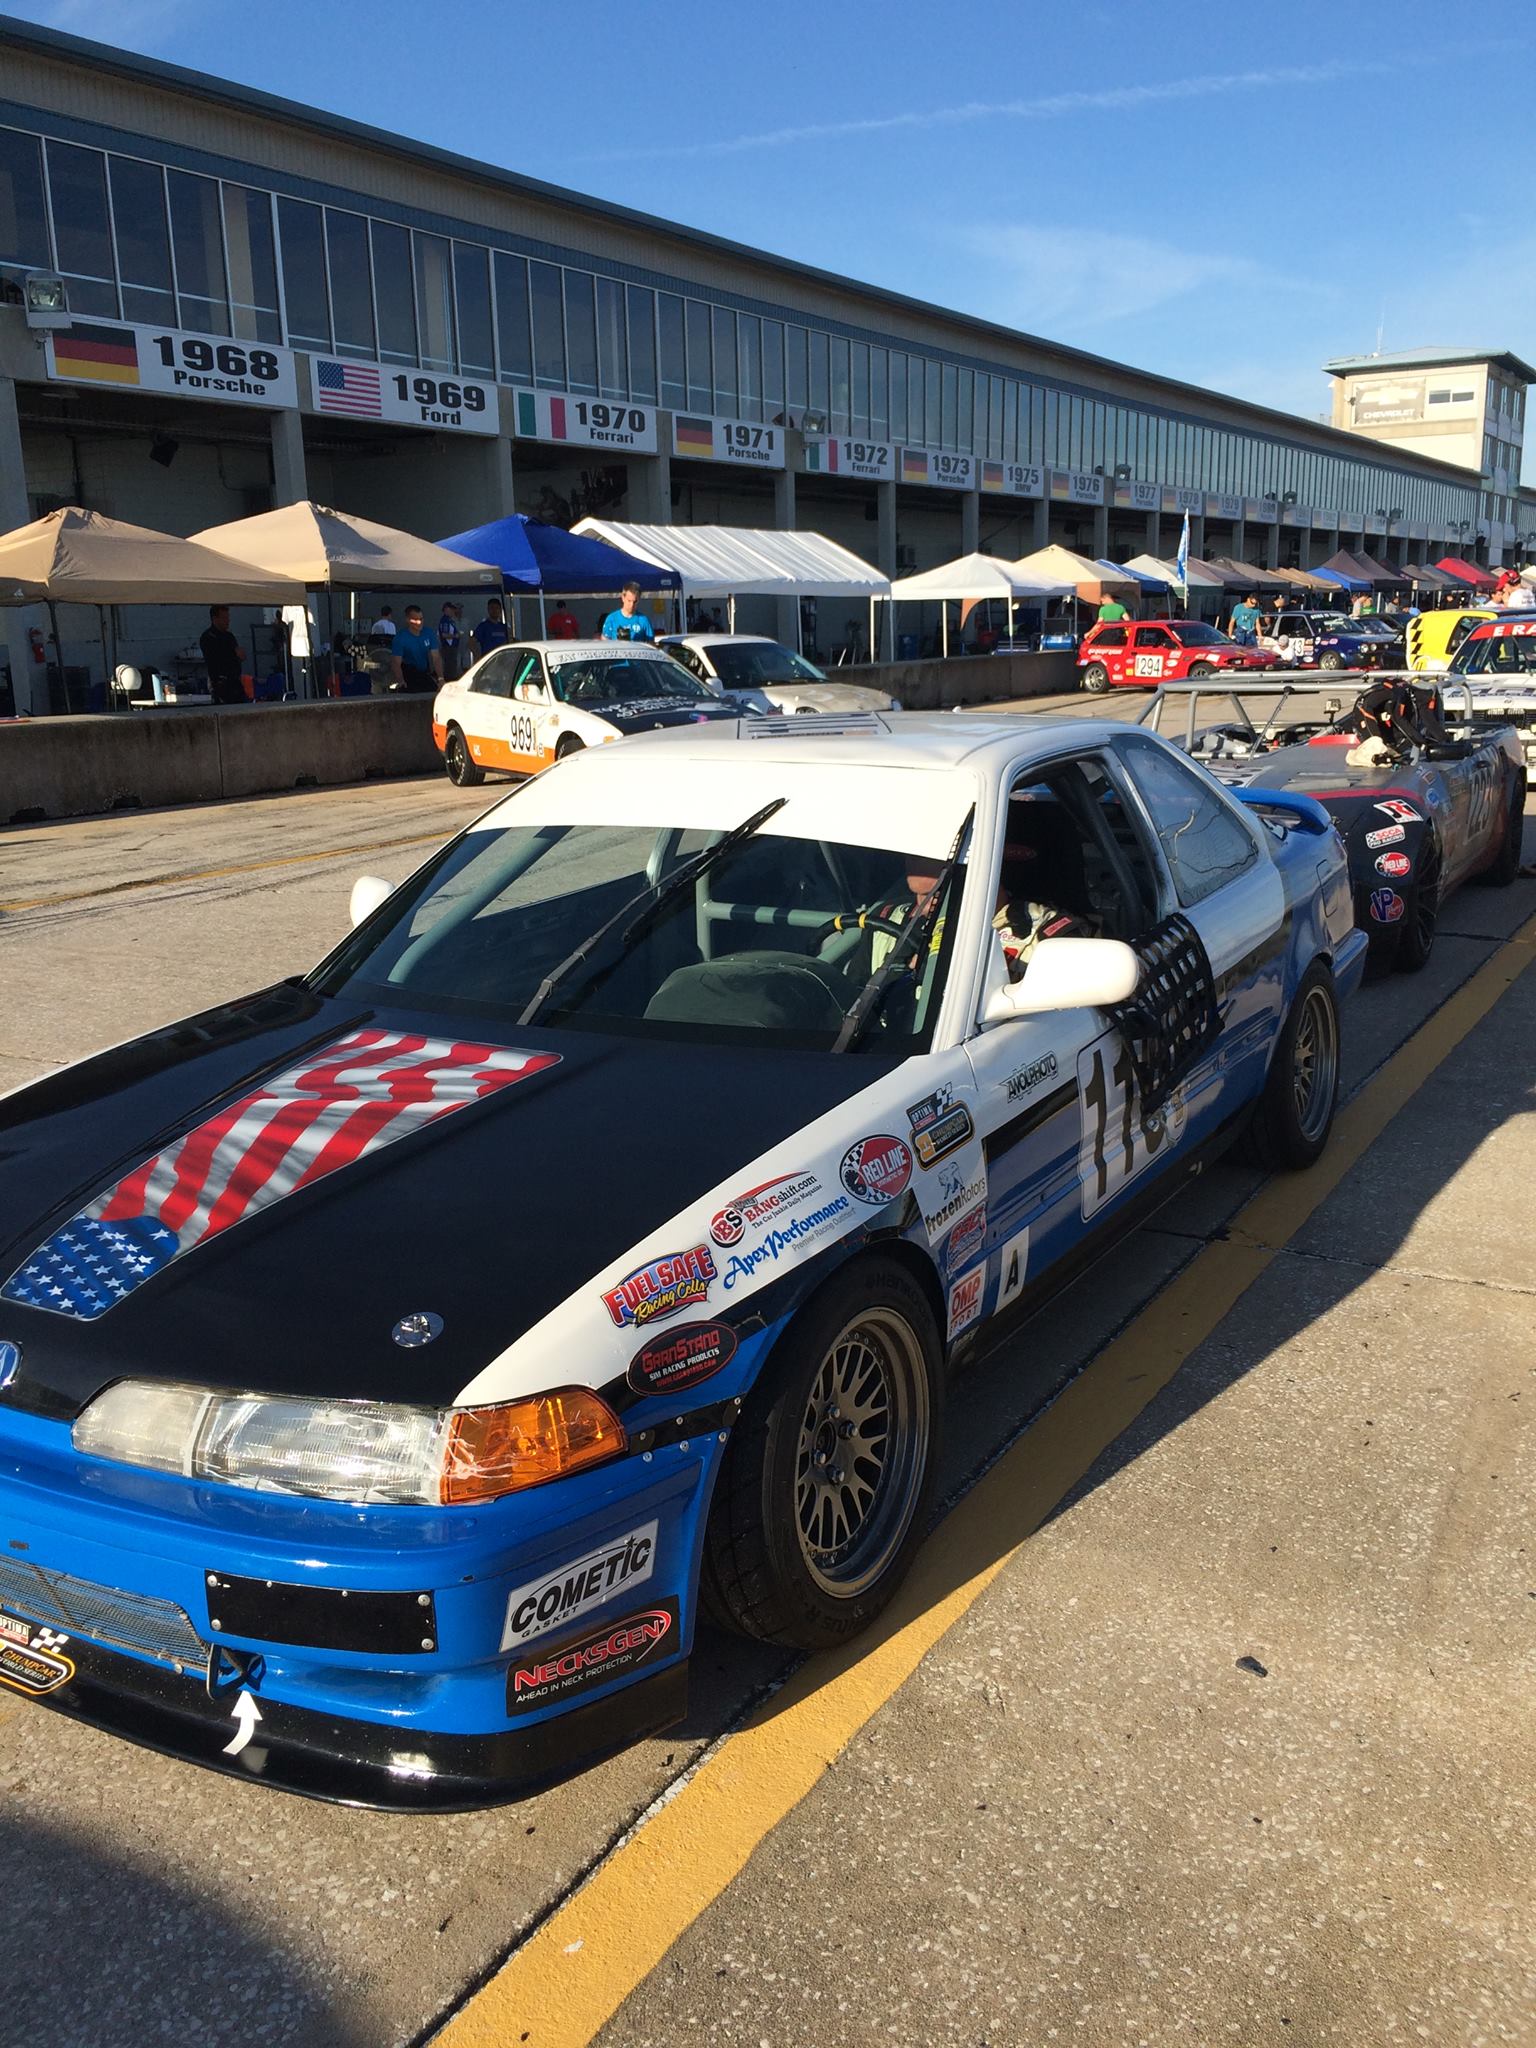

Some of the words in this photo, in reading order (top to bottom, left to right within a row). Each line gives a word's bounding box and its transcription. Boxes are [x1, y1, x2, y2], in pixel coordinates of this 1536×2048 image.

[153, 336, 280, 380] 1968
[174, 370, 266, 395] Porsche
[392, 374, 486, 412] 1969
[421, 406, 462, 426] Ford
[575, 402, 646, 432] 1970
[1363, 408, 1416, 419] CHEVROLET
[590, 427, 634, 445] Ferrari
[723, 424, 775, 450] 1971
[727, 445, 771, 461] Porsche
[844, 441, 888, 466] 1972
[932, 454, 970, 476] 1973
[851, 462, 880, 475] Ferrari
[937, 472, 966, 485] Porsche
[1007, 466, 1039, 485] 1975
[1073, 475, 1100, 493] 1976
[1134, 484, 1156, 500] 1977
[1140, 657, 1160, 676] 294
[511, 715, 532, 752] 969
[1370, 887, 1394, 921] VP
[861, 1157, 885, 1185] RED
[884, 1145, 908, 1173] LINE
[1004, 1248, 1019, 1296] A
[603, 1277, 661, 1327] FUEL
[655, 1246, 716, 1289] SAFE
[634, 1287, 676, 1322] Racing
[675, 1274, 706, 1299] Cells
[951, 1274, 981, 1316] OMP
[949, 1304, 978, 1337] SPORT
[650, 1367, 663, 1382] SIM
[662, 1359, 686, 1377] RACING
[686, 1347, 720, 1368] PRODUCTS
[511, 1536, 652, 1634] COMETIC
[521, 1605, 579, 1639] GASKET
[2, 1650, 57, 1678] CHUMPCAR
[23, 1667, 47, 1682] SERIES
[516, 1686, 548, 1703] AHEAD
[550, 1682, 560, 1693] IN
[561, 1674, 584, 1689] NECK
[585, 1653, 633, 1680] PROTECTION
